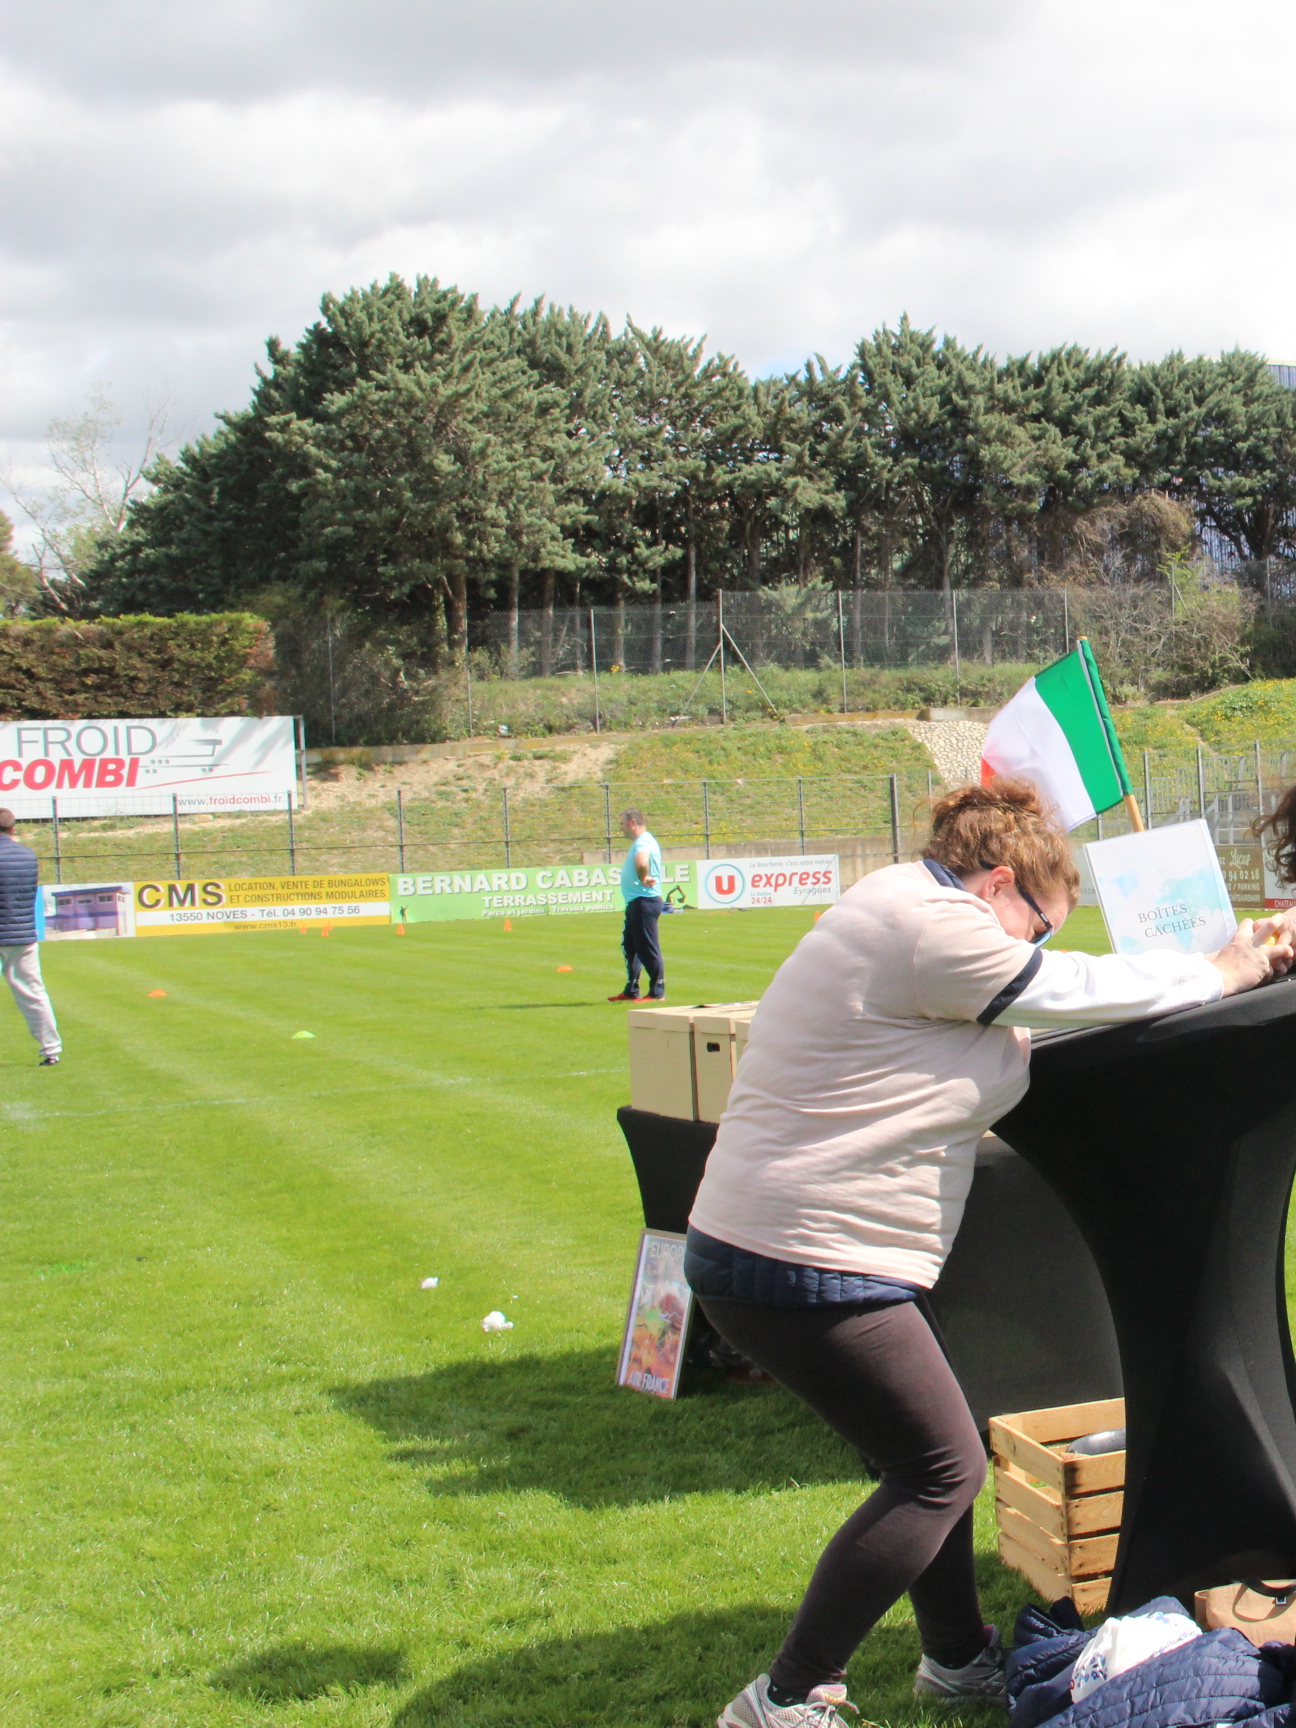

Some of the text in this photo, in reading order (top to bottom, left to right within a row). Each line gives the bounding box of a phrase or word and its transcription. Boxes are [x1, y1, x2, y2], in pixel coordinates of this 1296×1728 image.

[17, 725, 158, 758] FROID
[0, 757, 140, 792] COMBI
[178, 794, 283, 807] www.froidcombi.fr
[397, 864, 692, 897] BERNARD CABASLE
[750, 870, 833, 893] express
[1240, 870, 1249, 880] 02
[1251, 868, 1260, 880] 18
[229, 877, 387, 892] LOCATION, VENTE DE BUNGALOWS
[793, 886, 832, 897] Eyragues
[1237, 882, 1260, 891] PARKING
[137, 881, 226, 910] CMS
[230, 889, 387, 904] ET CONSTRUCTIONS MODULAIRES
[481, 889, 615, 909] TERRASSEMENT
[751, 896, 773, 905] 24/24
[170, 911, 204, 922] 13550
[206, 909, 248, 921] NOVES
[259, 908, 280, 918] Tél.
[282, 908, 296, 917] 04
[299, 907, 313, 917] 90
[315, 906, 329, 916] 94
[331, 905, 345, 915] 75
[347, 904, 361, 915] 56
[482, 903, 615, 917] Parcs et jardins Travaux publics
[1144, 915, 1206, 938] CACHÉES
[649, 1241, 686, 1262] EUROP
[627, 1369, 670, 1395] AIR FRANCE
